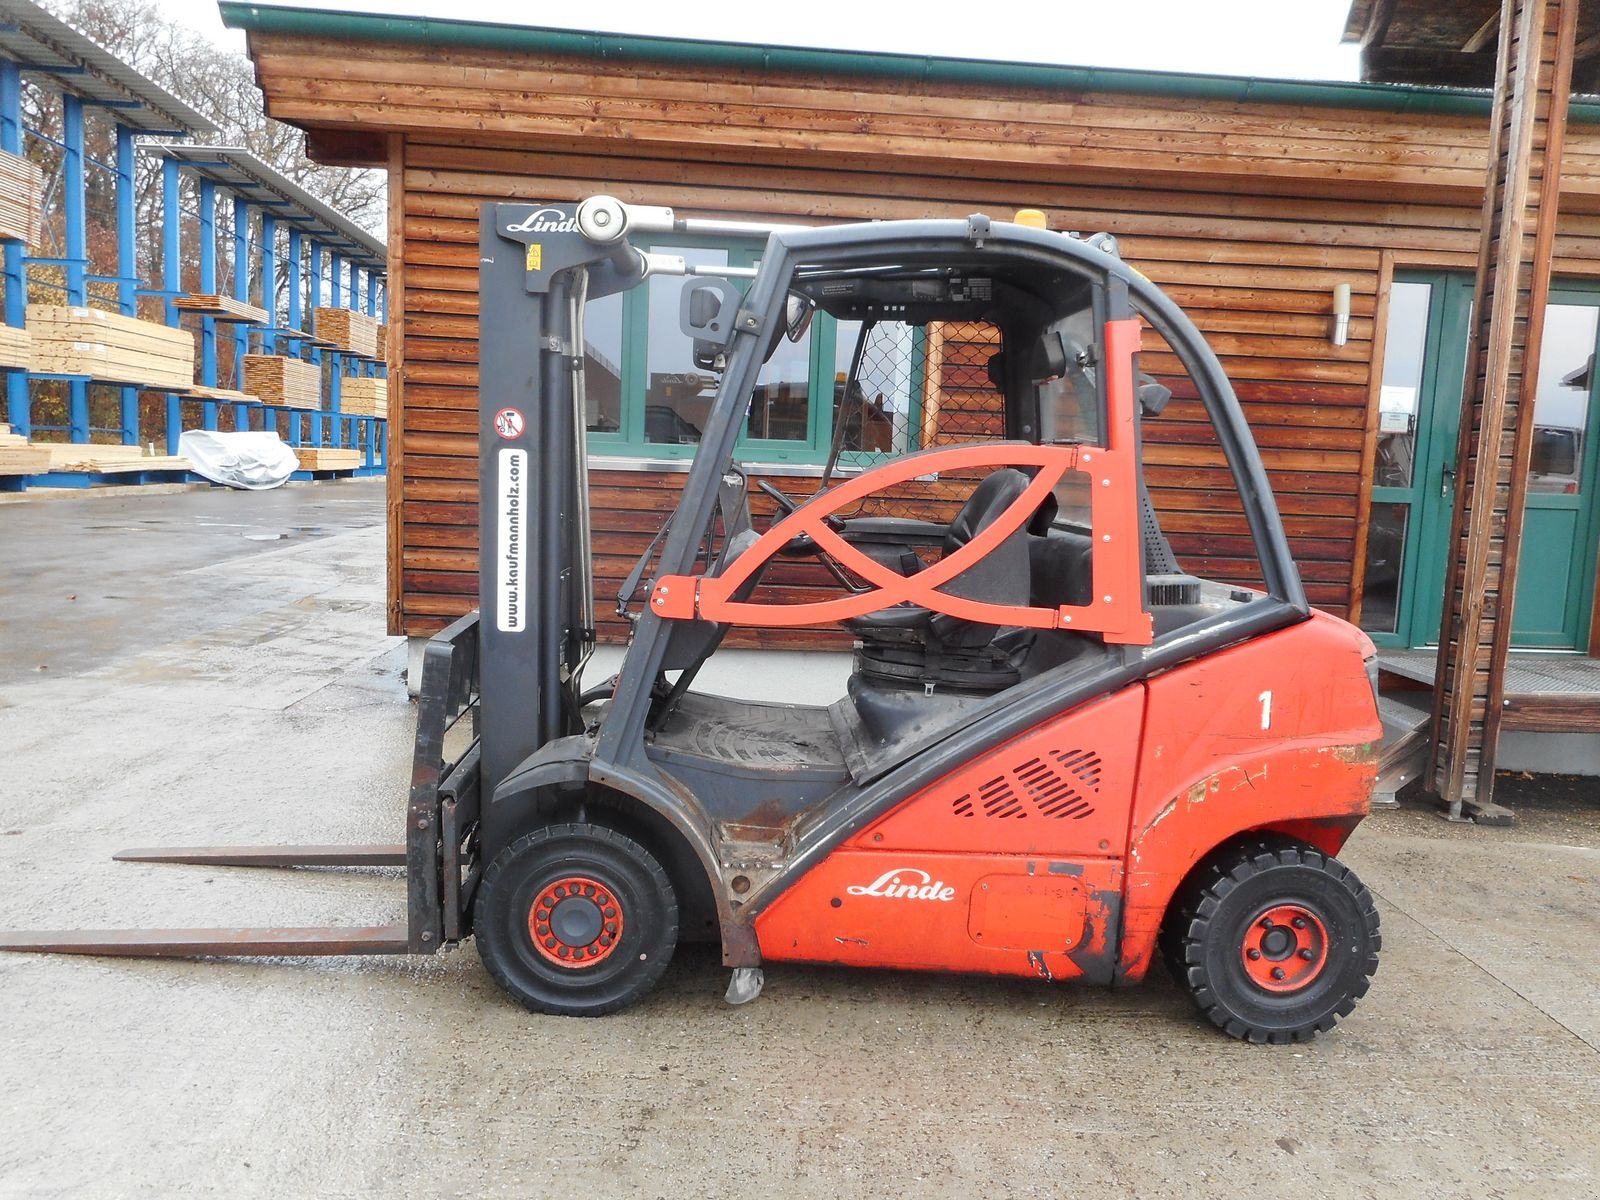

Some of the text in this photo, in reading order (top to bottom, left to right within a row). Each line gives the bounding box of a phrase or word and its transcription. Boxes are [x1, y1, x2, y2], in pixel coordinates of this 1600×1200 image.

[506, 455, 520, 628] www.kaufmannholz.com
[1258, 690, 1273, 730] 1
[846, 868, 955, 901] Linde
